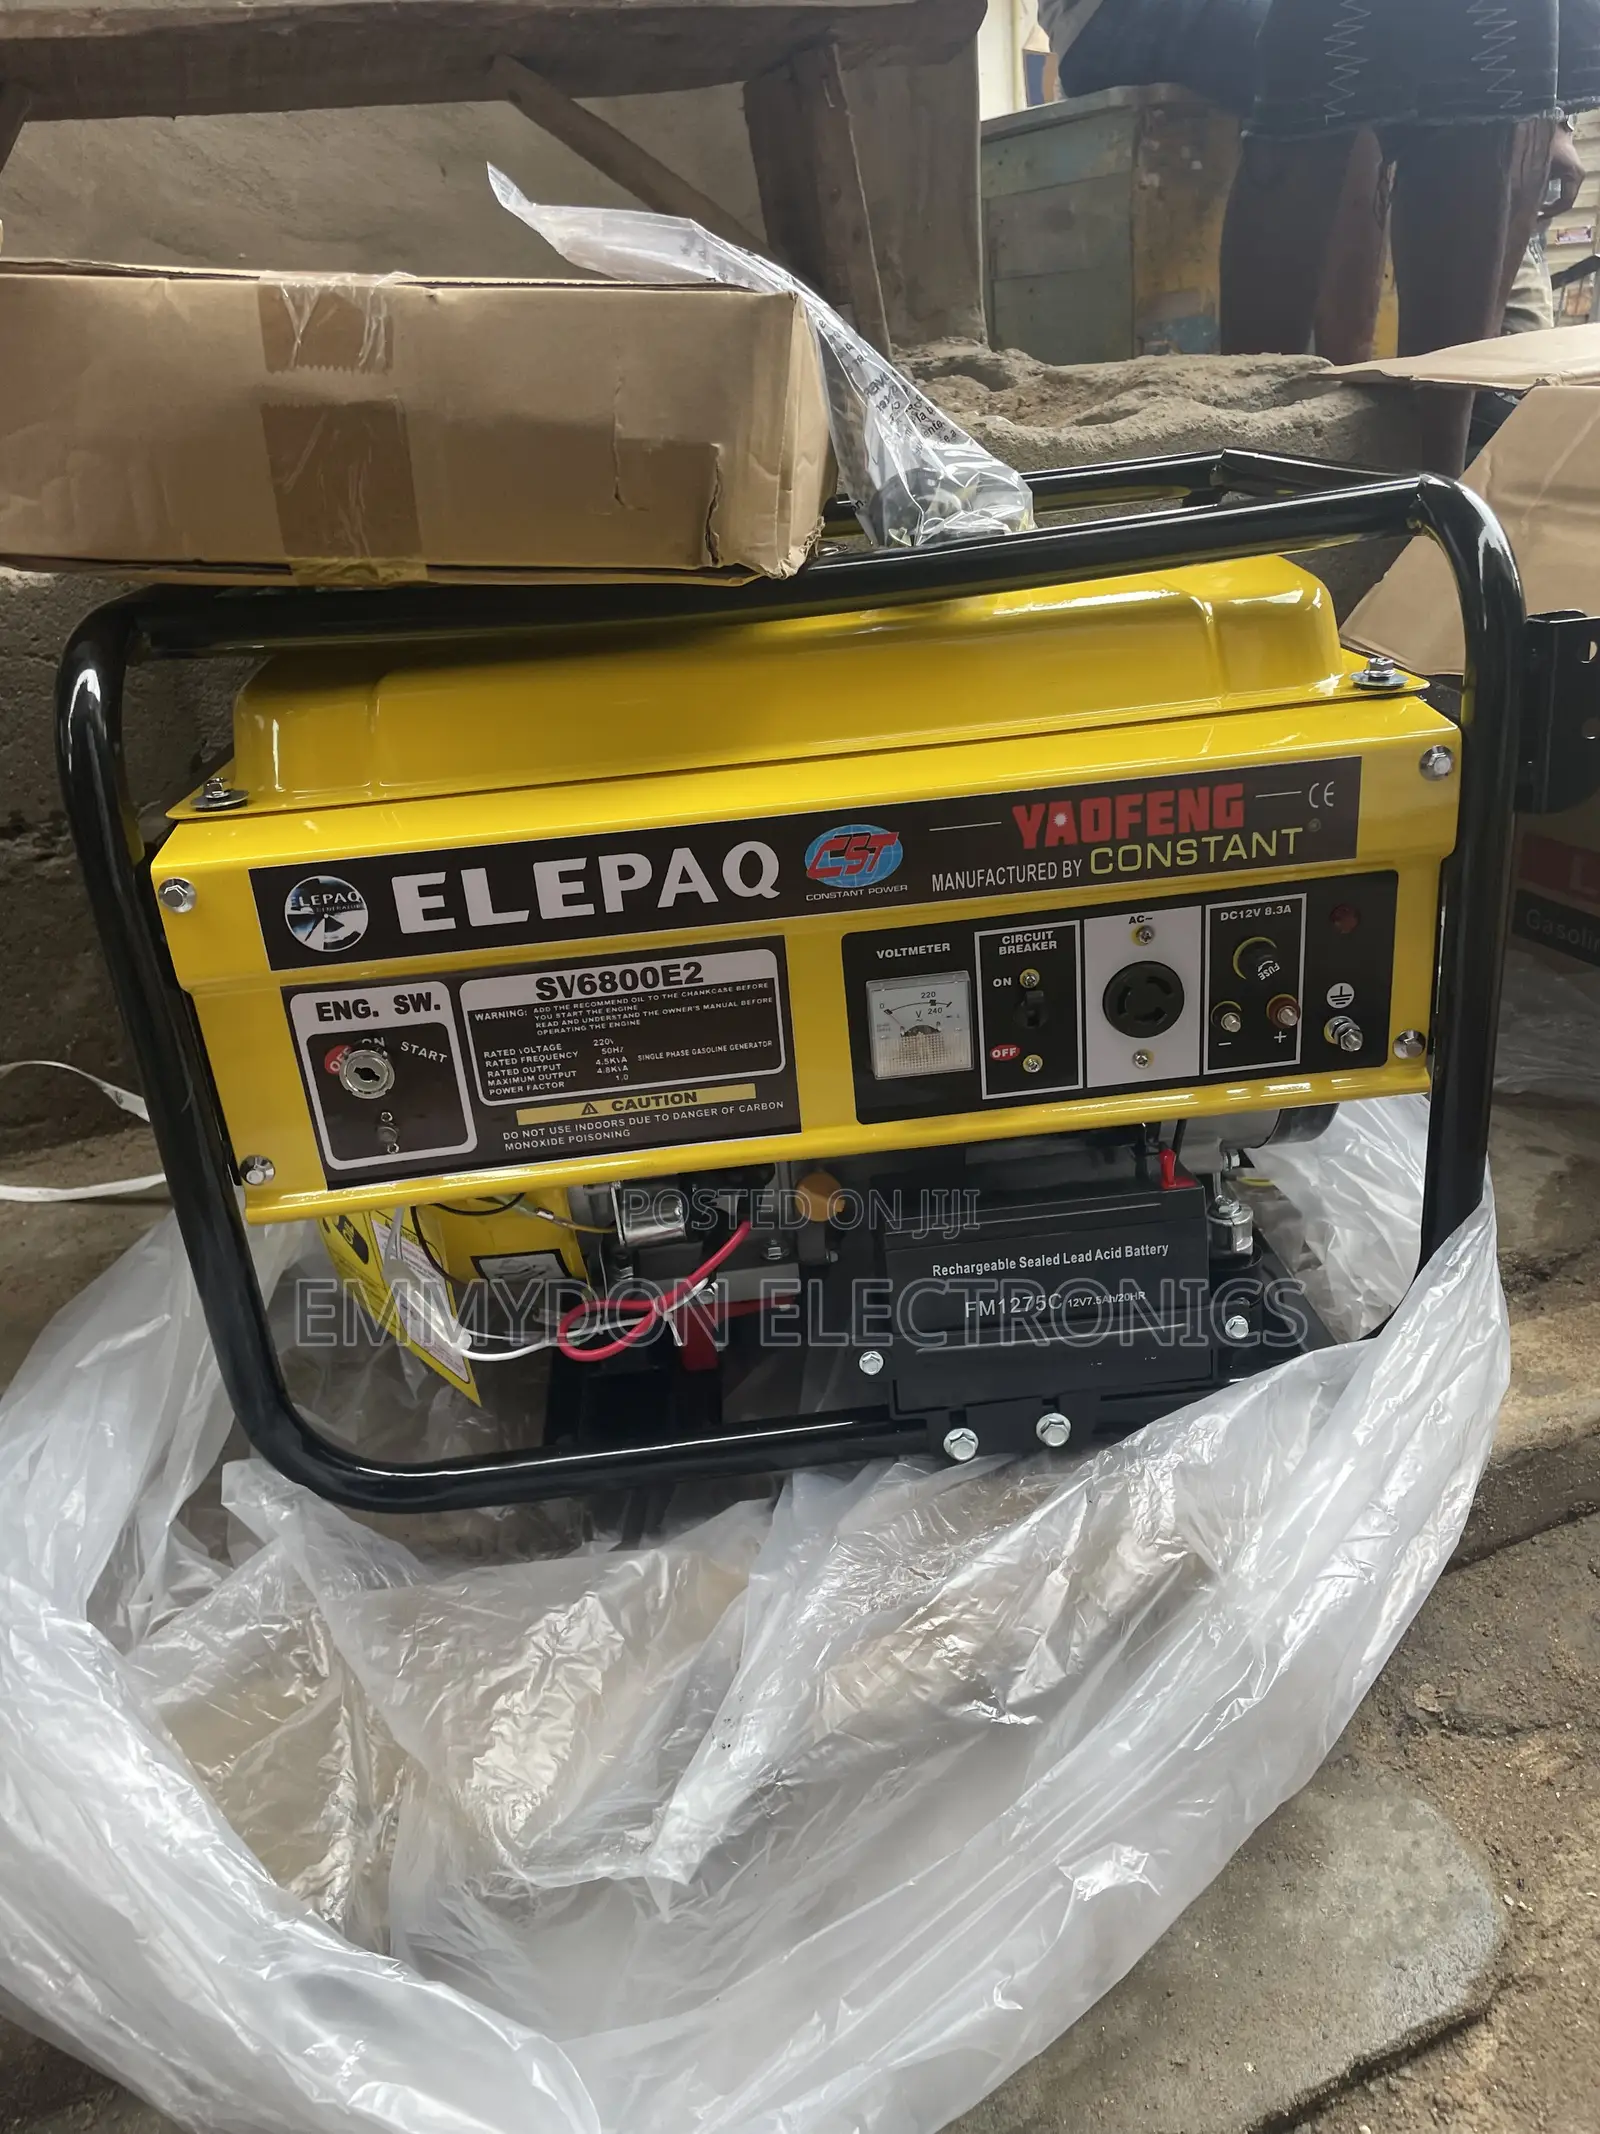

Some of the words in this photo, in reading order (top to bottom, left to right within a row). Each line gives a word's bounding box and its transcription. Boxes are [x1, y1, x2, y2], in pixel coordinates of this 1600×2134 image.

[1309, 781, 1334, 808] CE
[1011, 783, 1244, 849] YAOFENG
[807, 832, 899, 880] CST
[931, 860, 1058, 892] MANUFACTURED
[1062, 858, 1082, 879] BY
[1090, 827, 1303, 875] CONSTANT
[391, 841, 781, 935] ELEPAQ
[806, 889, 864, 901] CONSTANT
[868, 885, 908, 895] POWER
[291, 892, 361, 907] ELEPAQ
[1220, 908, 1261, 921] DC12V
[1264, 904, 1292, 916] 8.3A
[998, 940, 1058, 955] BREAKER
[1002, 931, 1054, 945] CIRCUIT
[876, 942, 951, 959] VOLTMETER
[1257, 962, 1281, 981] FUSE
[535, 962, 704, 1001] SV6800E2
[993, 977, 1012, 987] ON
[533, 1006, 551, 1014] ADD
[573, 998, 629, 1009] RECOMMEND
[736, 983, 768, 991] BEFORE
[921, 991, 936, 999] 220
[315, 998, 379, 1022] ENG.
[393, 992, 441, 1014] SW.
[475, 1009, 528, 1022] WARNING:
[535, 1021, 559, 1029] READ
[582, 1012, 640, 1024] UNDERSTAND
[643, 1009, 659, 1017] THE
[662, 1005, 701, 1015] OWNER'S
[703, 1001, 738, 1010] MANUAL
[741, 997, 773, 1006] BEFORE
[556, 1010, 583, 1019] START
[606, 1005, 638, 1013] ENGINE
[927, 1007, 943, 1015] 240
[537, 1025, 587, 1036] OPERATING
[589, 1022, 606, 1030] THE
[609, 1019, 641, 1028] ENGINE
[400, 1041, 448, 1063] START
[483, 1049, 516, 1058] RATED
[485, 1058, 518, 1067] RATED
[520, 1051, 579, 1064] FREQUENCY
[637, 1052, 664, 1061] SINGLE
[665, 1049, 690, 1058] PHASE
[691, 1045, 728, 1055] GASOLINE
[729, 1040, 773, 1051] GENERATOR
[992, 1047, 1017, 1058] OFF
[487, 1069, 519, 1078] RATED
[522, 1063, 562, 1074] OUTPUT
[487, 1076, 535, 1087] MAXIMUM
[537, 1070, 577, 1081] OUTPUT
[489, 1087, 524, 1096] POWER
[526, 1081, 565, 1091] FACTOR
[615, 1074, 629, 1082] 1.0
[611, 1091, 698, 1112] CAUTION
[502, 1130, 519, 1141] DO
[522, 1128, 545, 1138] NOT
[549, 1124, 572, 1135] USE
[575, 1118, 625, 1132] INDOORS
[629, 1115, 651, 1126] DUE
[654, 1113, 670, 1123] TO
[672, 1107, 718, 1121] DANGER
[721, 1106, 736, 1115] OF
[738, 1101, 784, 1113] CARBON
[504, 1138, 565, 1152] MONOXIDE
[568, 1129, 631, 1144] POISONING
[932, 1257, 1016, 1277] Rechargeable
[1019, 1252, 1060, 1269] Sealed
[1063, 1249, 1093, 1265] Lead
[1095, 1246, 1122, 1261] Acid
[1125, 1243, 1169, 1258] Battery
[965, 1293, 1062, 1318] FM1275C
